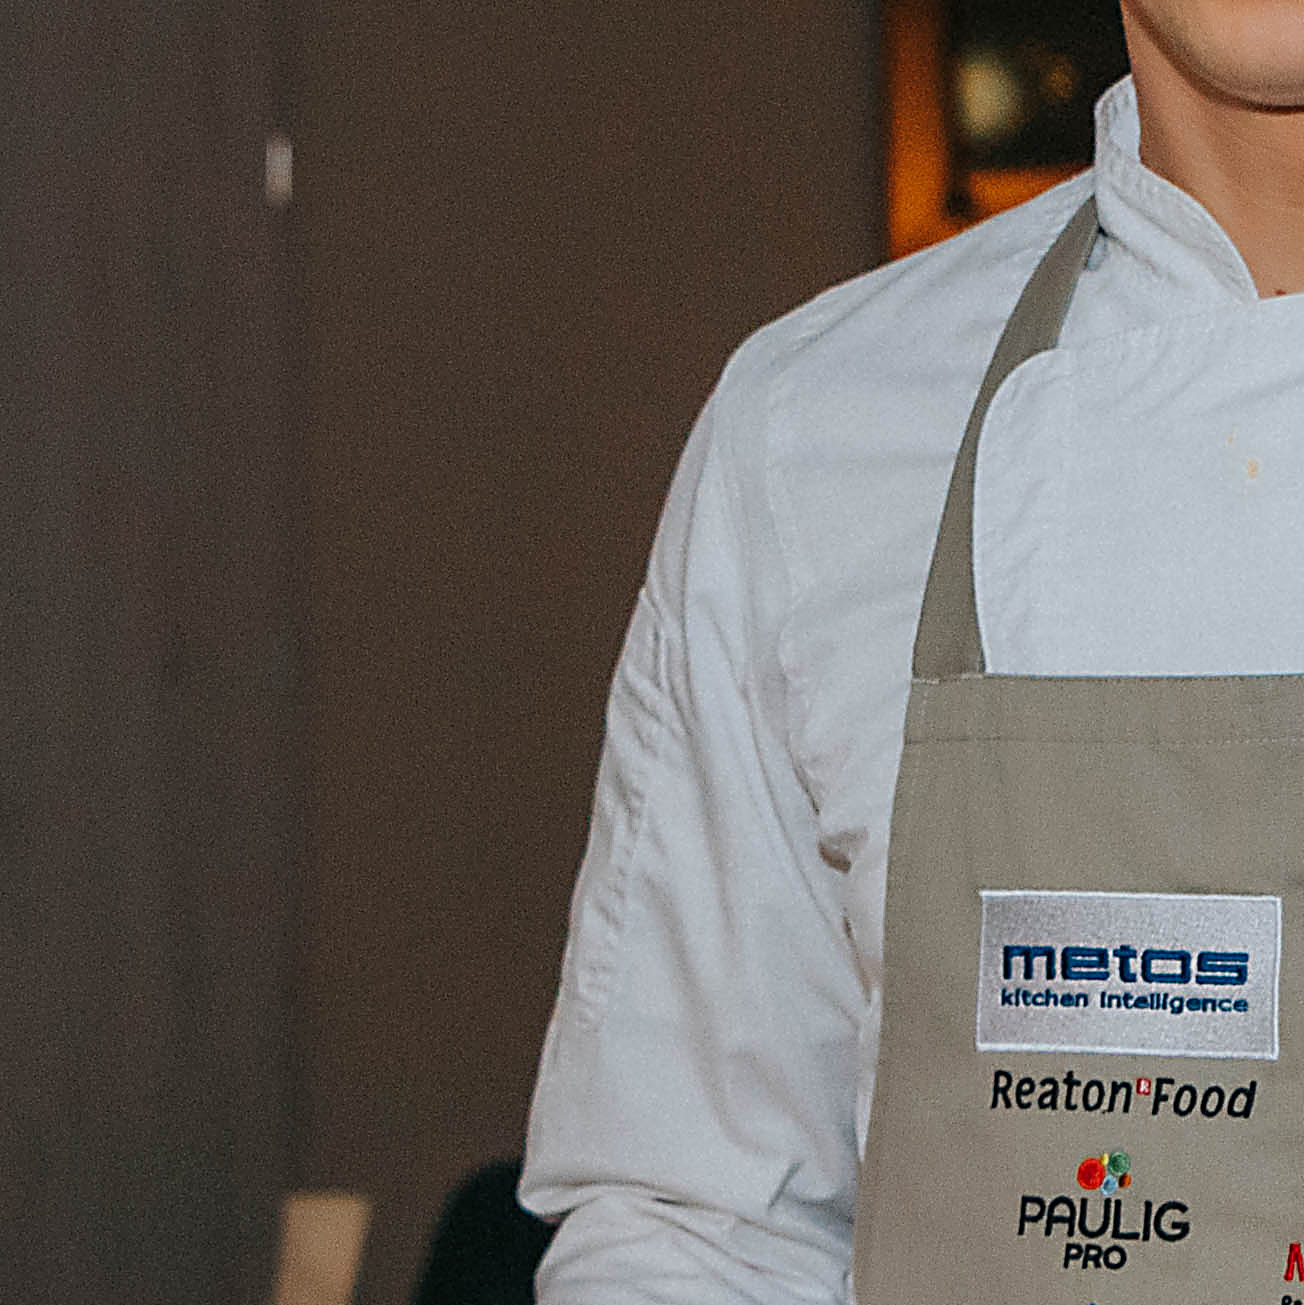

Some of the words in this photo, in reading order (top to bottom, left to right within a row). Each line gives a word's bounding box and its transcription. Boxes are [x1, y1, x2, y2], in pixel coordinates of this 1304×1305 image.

[1002, 945, 1249, 985] metos
[1001, 988, 1089, 1008] kitchen
[1100, 991, 1249, 1014] intelligence
[991, 1069, 1133, 1114] Reaton
[1151, 1077, 1257, 1119] Food
[1017, 1195, 1190, 1242] PAULIG
[1063, 1244, 1127, 1270] PRO
